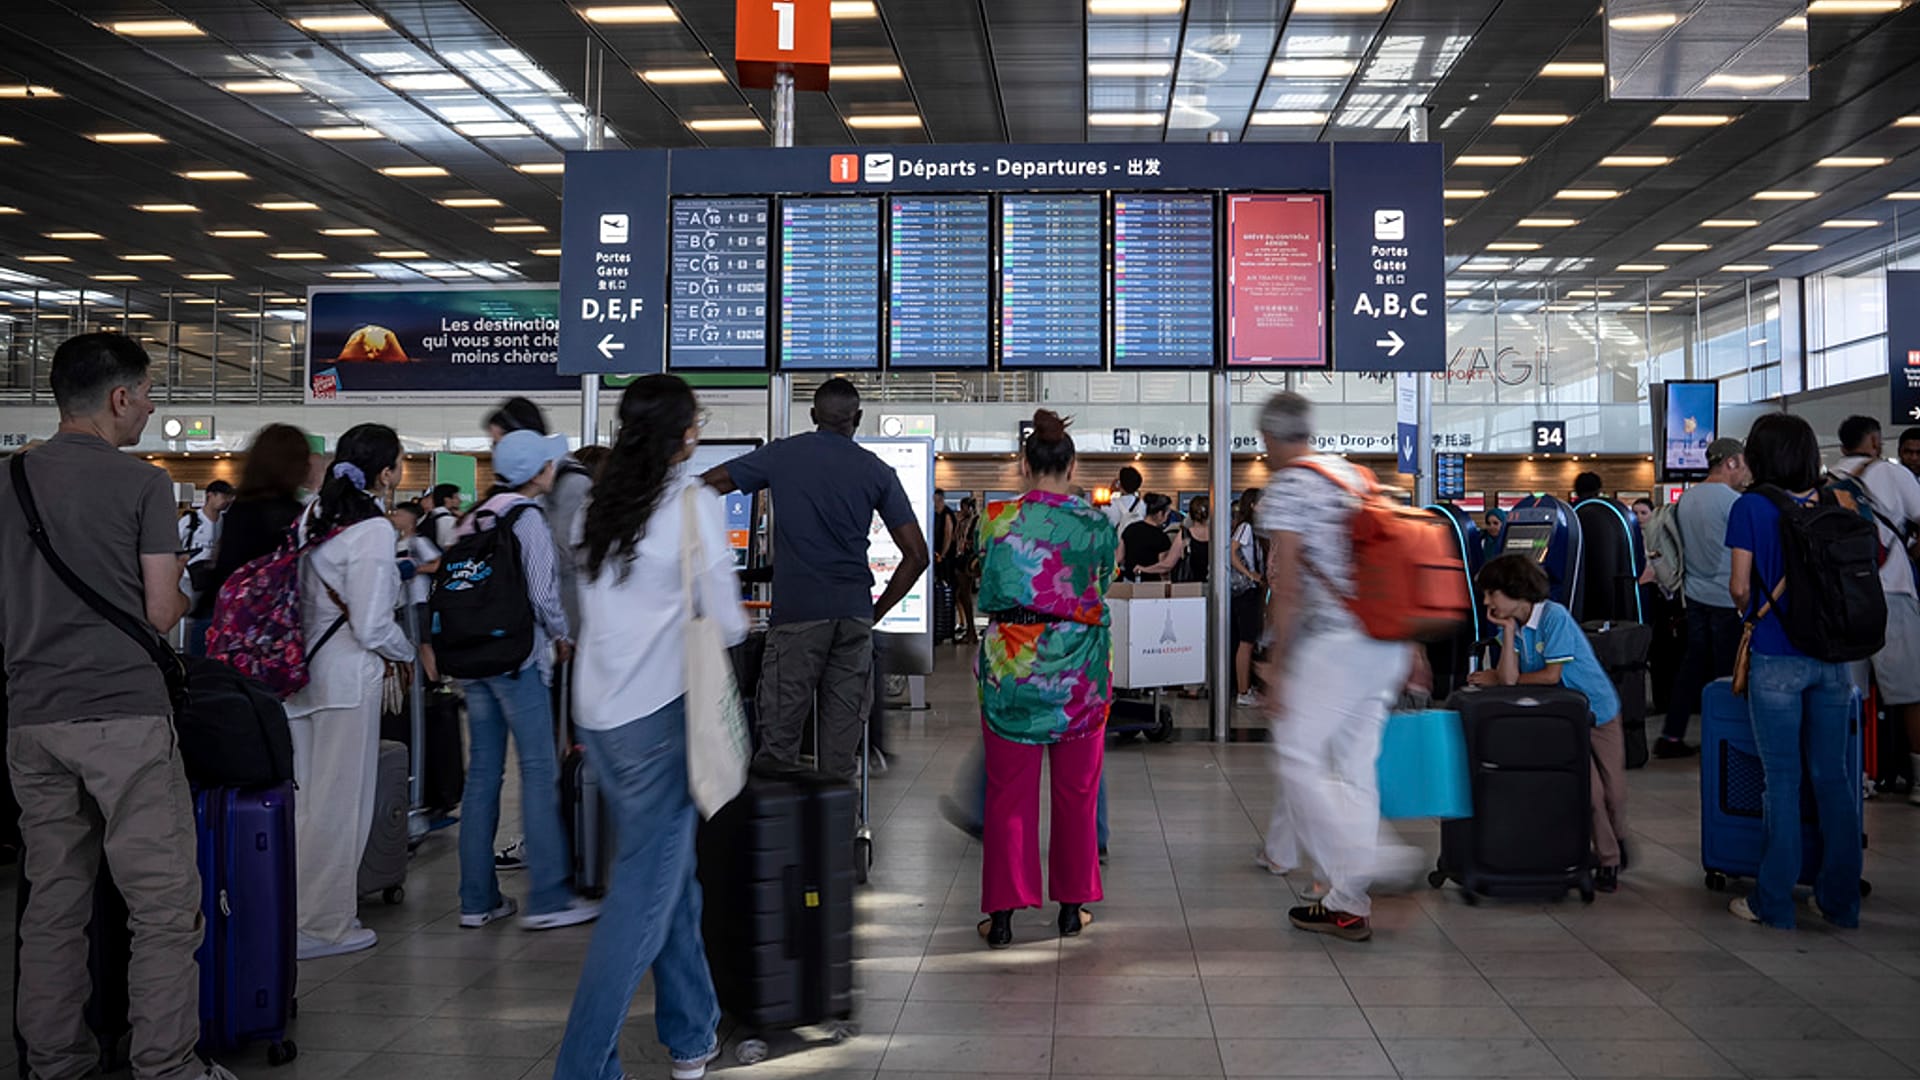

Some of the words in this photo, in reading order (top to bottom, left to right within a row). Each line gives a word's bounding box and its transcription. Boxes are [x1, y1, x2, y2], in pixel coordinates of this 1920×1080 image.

[772, 2, 795, 50] 1
[899, 159, 977, 181] Départs
[996, 159, 1107, 179] Departures
[1127, 158, 1161, 176] 出发
[690, 212, 701, 225] A
[690, 235, 701, 248] B
[595, 252, 631, 263] Portes
[1371, 245, 1409, 257] Portes
[596, 266, 629, 277] Gates
[689, 259, 700, 271] C
[1373, 259, 1407, 271] Gates
[597, 279, 627, 291] 登机口
[1375, 273, 1406, 285] 登机口
[688, 281, 700, 295] D
[581, 298, 643, 323] D,E,F
[689, 305, 699, 319] E
[1353, 292, 1428, 319] A,B,C
[441, 317, 470, 332] Les
[688, 328, 699, 341] F
[423, 333, 448, 351] qui
[452, 335, 490, 347] vous
[493, 334, 530, 347] sont
[451, 349, 500, 363] moins
[503, 349, 558, 363] chères
[1139, 433, 1193, 448] Dépose
[1341, 433, 1397, 448] Drop-of
[1537, 427, 1563, 446] 34
